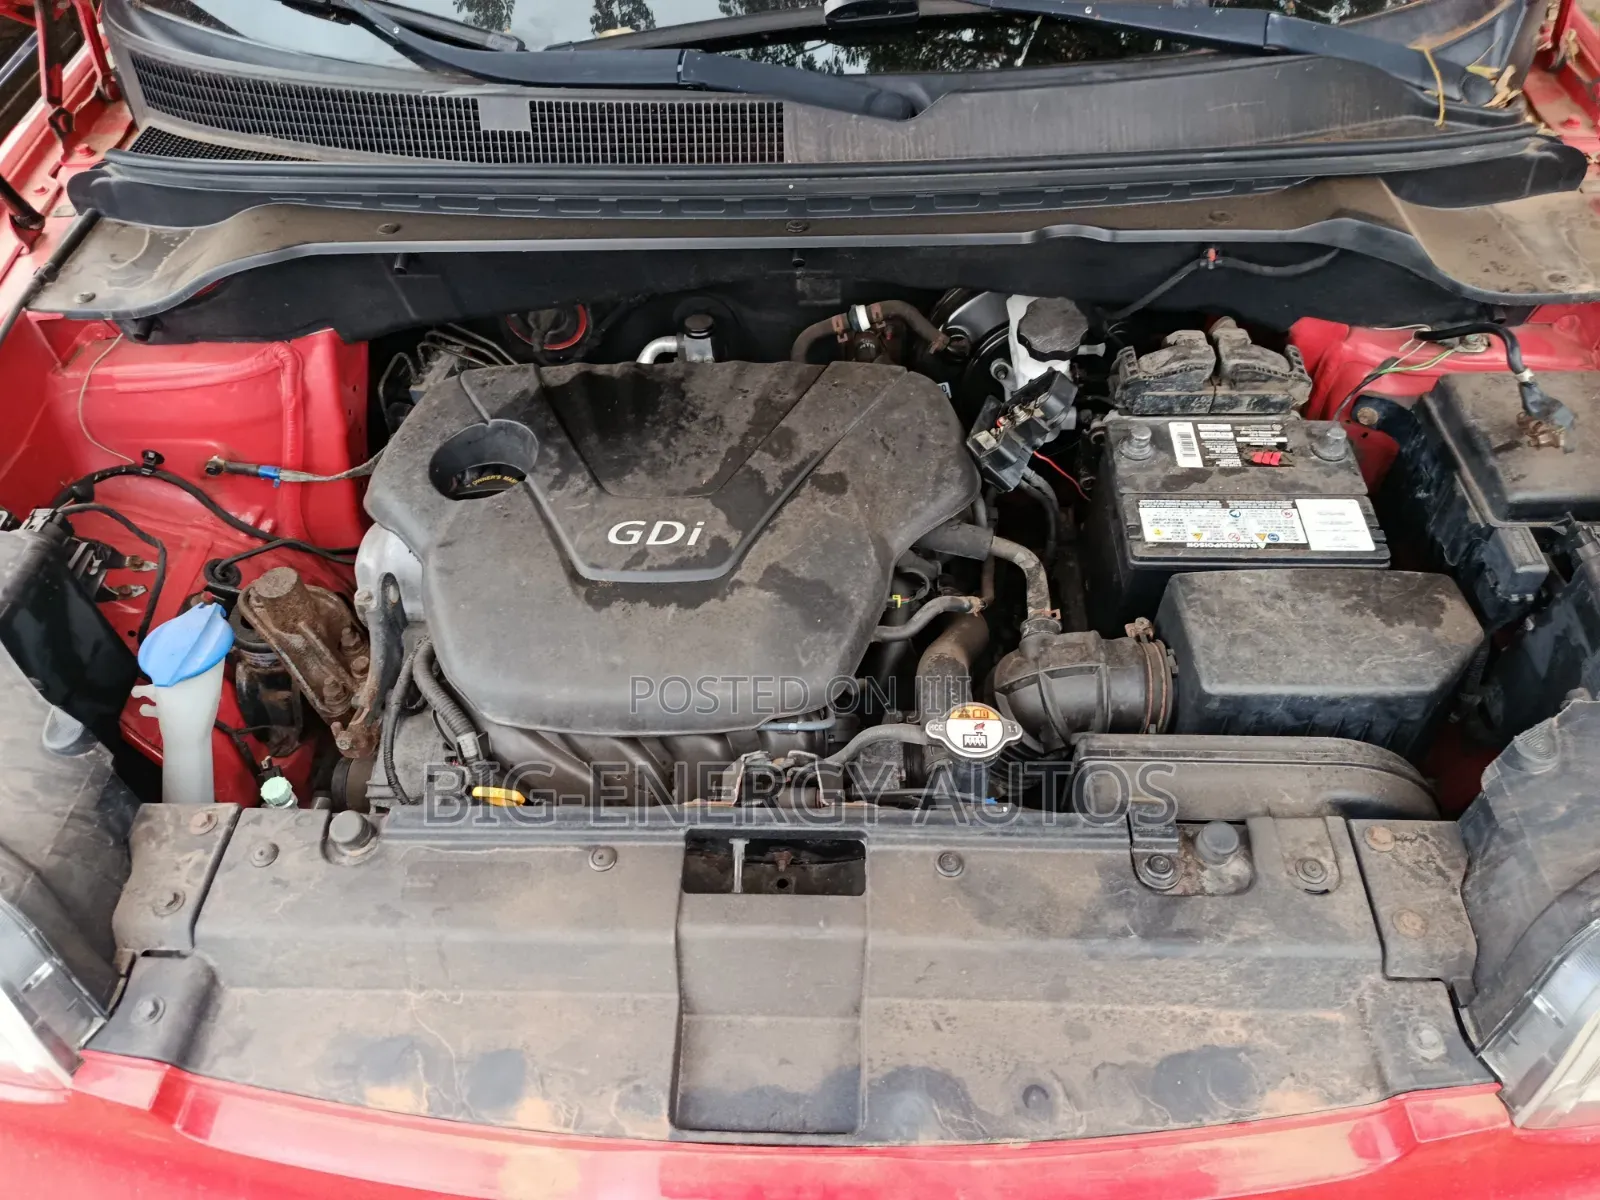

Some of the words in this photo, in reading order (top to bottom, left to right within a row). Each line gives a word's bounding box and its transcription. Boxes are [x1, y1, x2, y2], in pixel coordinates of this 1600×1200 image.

[472, 475, 502, 486] OWNER'S
[503, 476, 519, 485] MAN
[607, 520, 705, 546] GDi
[928, 723, 944, 732] HCC
